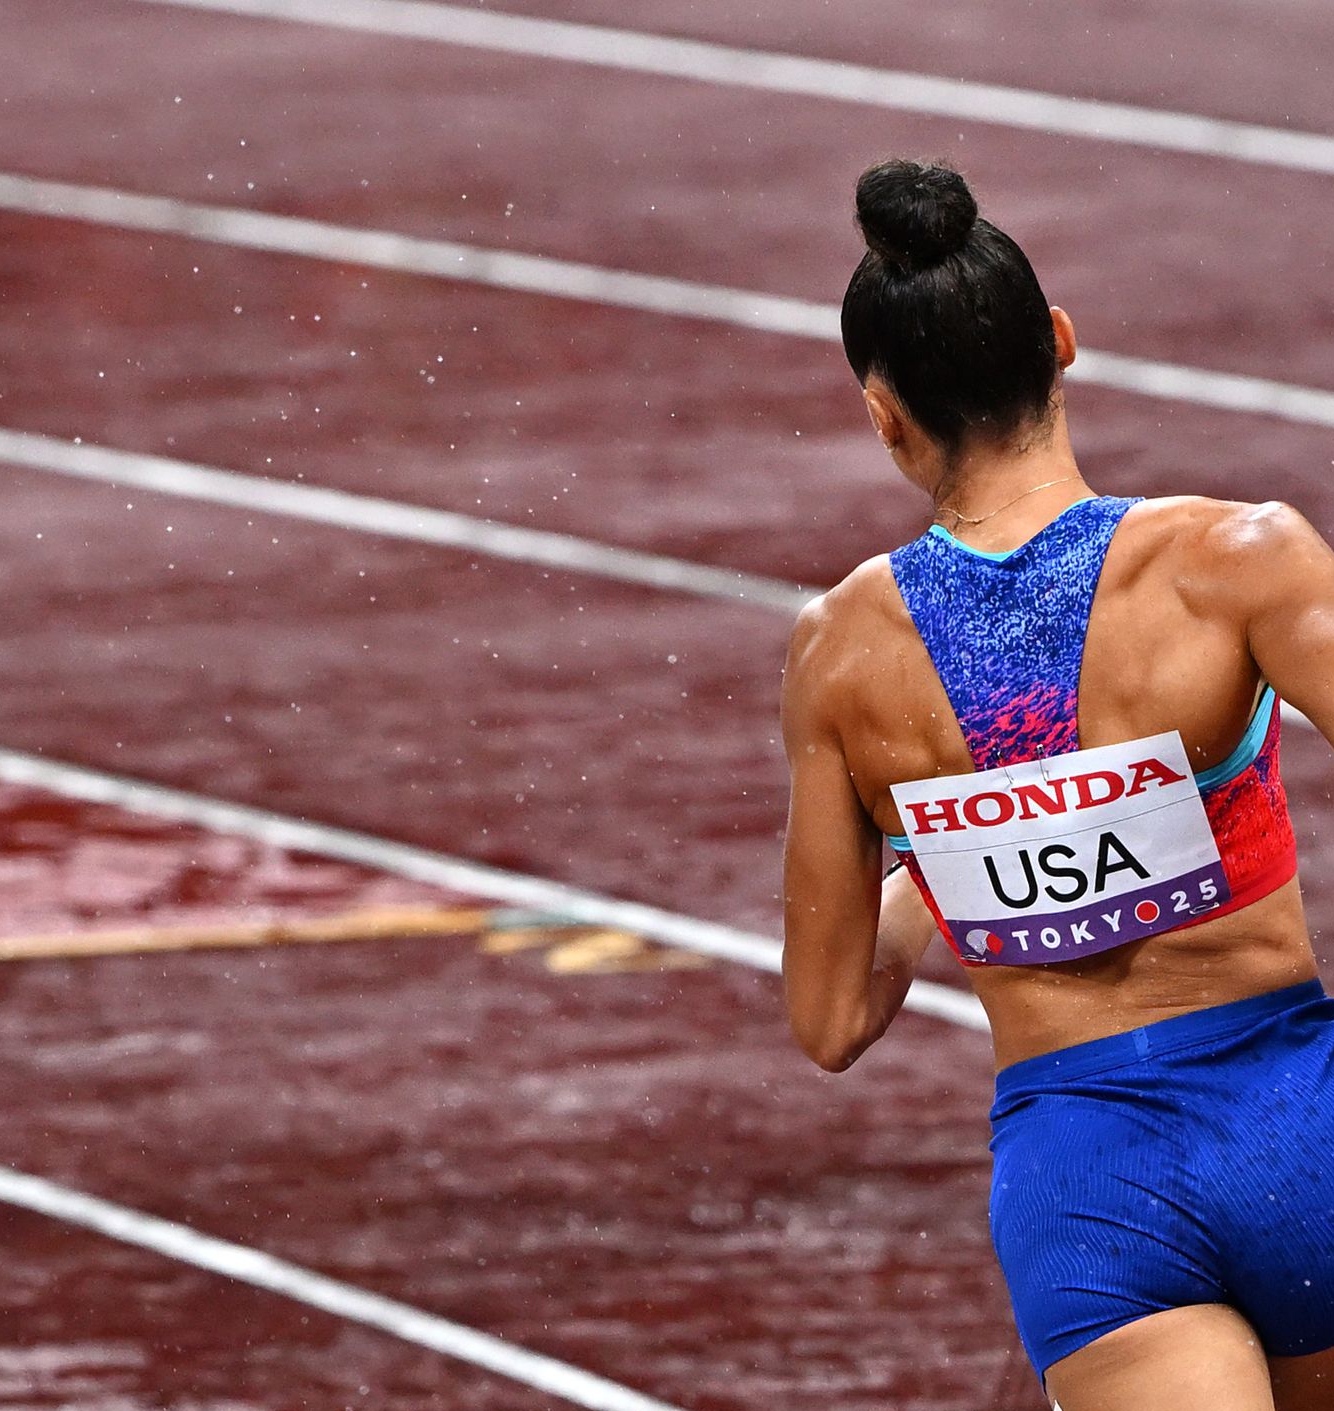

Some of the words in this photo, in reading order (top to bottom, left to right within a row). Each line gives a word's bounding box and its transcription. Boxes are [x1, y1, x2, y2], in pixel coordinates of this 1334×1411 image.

[905, 758, 1187, 835] HONDA
[982, 831, 1151, 909] USA
[1170, 878, 1218, 913] 25
